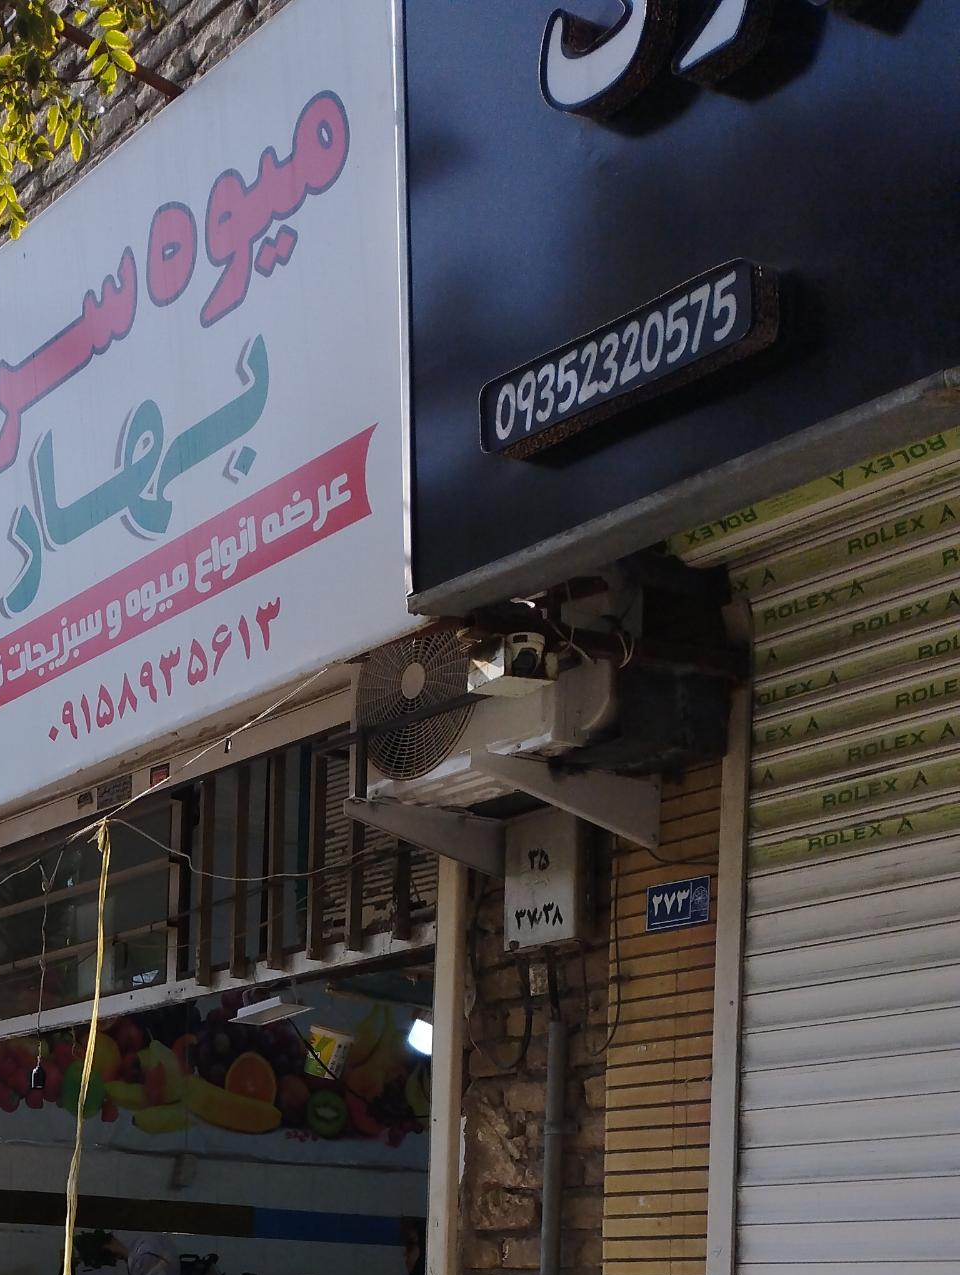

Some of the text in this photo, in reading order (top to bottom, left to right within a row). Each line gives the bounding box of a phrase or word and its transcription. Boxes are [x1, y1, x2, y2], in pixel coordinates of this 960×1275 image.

[146, 89, 350, 328] میوه
[495, 271, 737, 440] 09352320575
[262, 473, 352, 543] عرضه
[847, 515, 926, 554] ROLEX
[194, 516, 257, 594] انواع
[125, 563, 189, 622] میوه
[763, 588, 835, 624] ROLEX
[106, 600, 122, 640] و
[851, 600, 930, 635] ROLEX
[7, 608, 103, 682] سبزیجات
[48, 597, 281, 742] ۰۹۱۵۸۹۳۵۶۱۳
[848, 728, 927, 762] ROLEX
[822, 777, 898, 811] ROLEX
[808, 822, 883, 851] ROLEX
[652, 888, 691, 917] ۲۷۳
